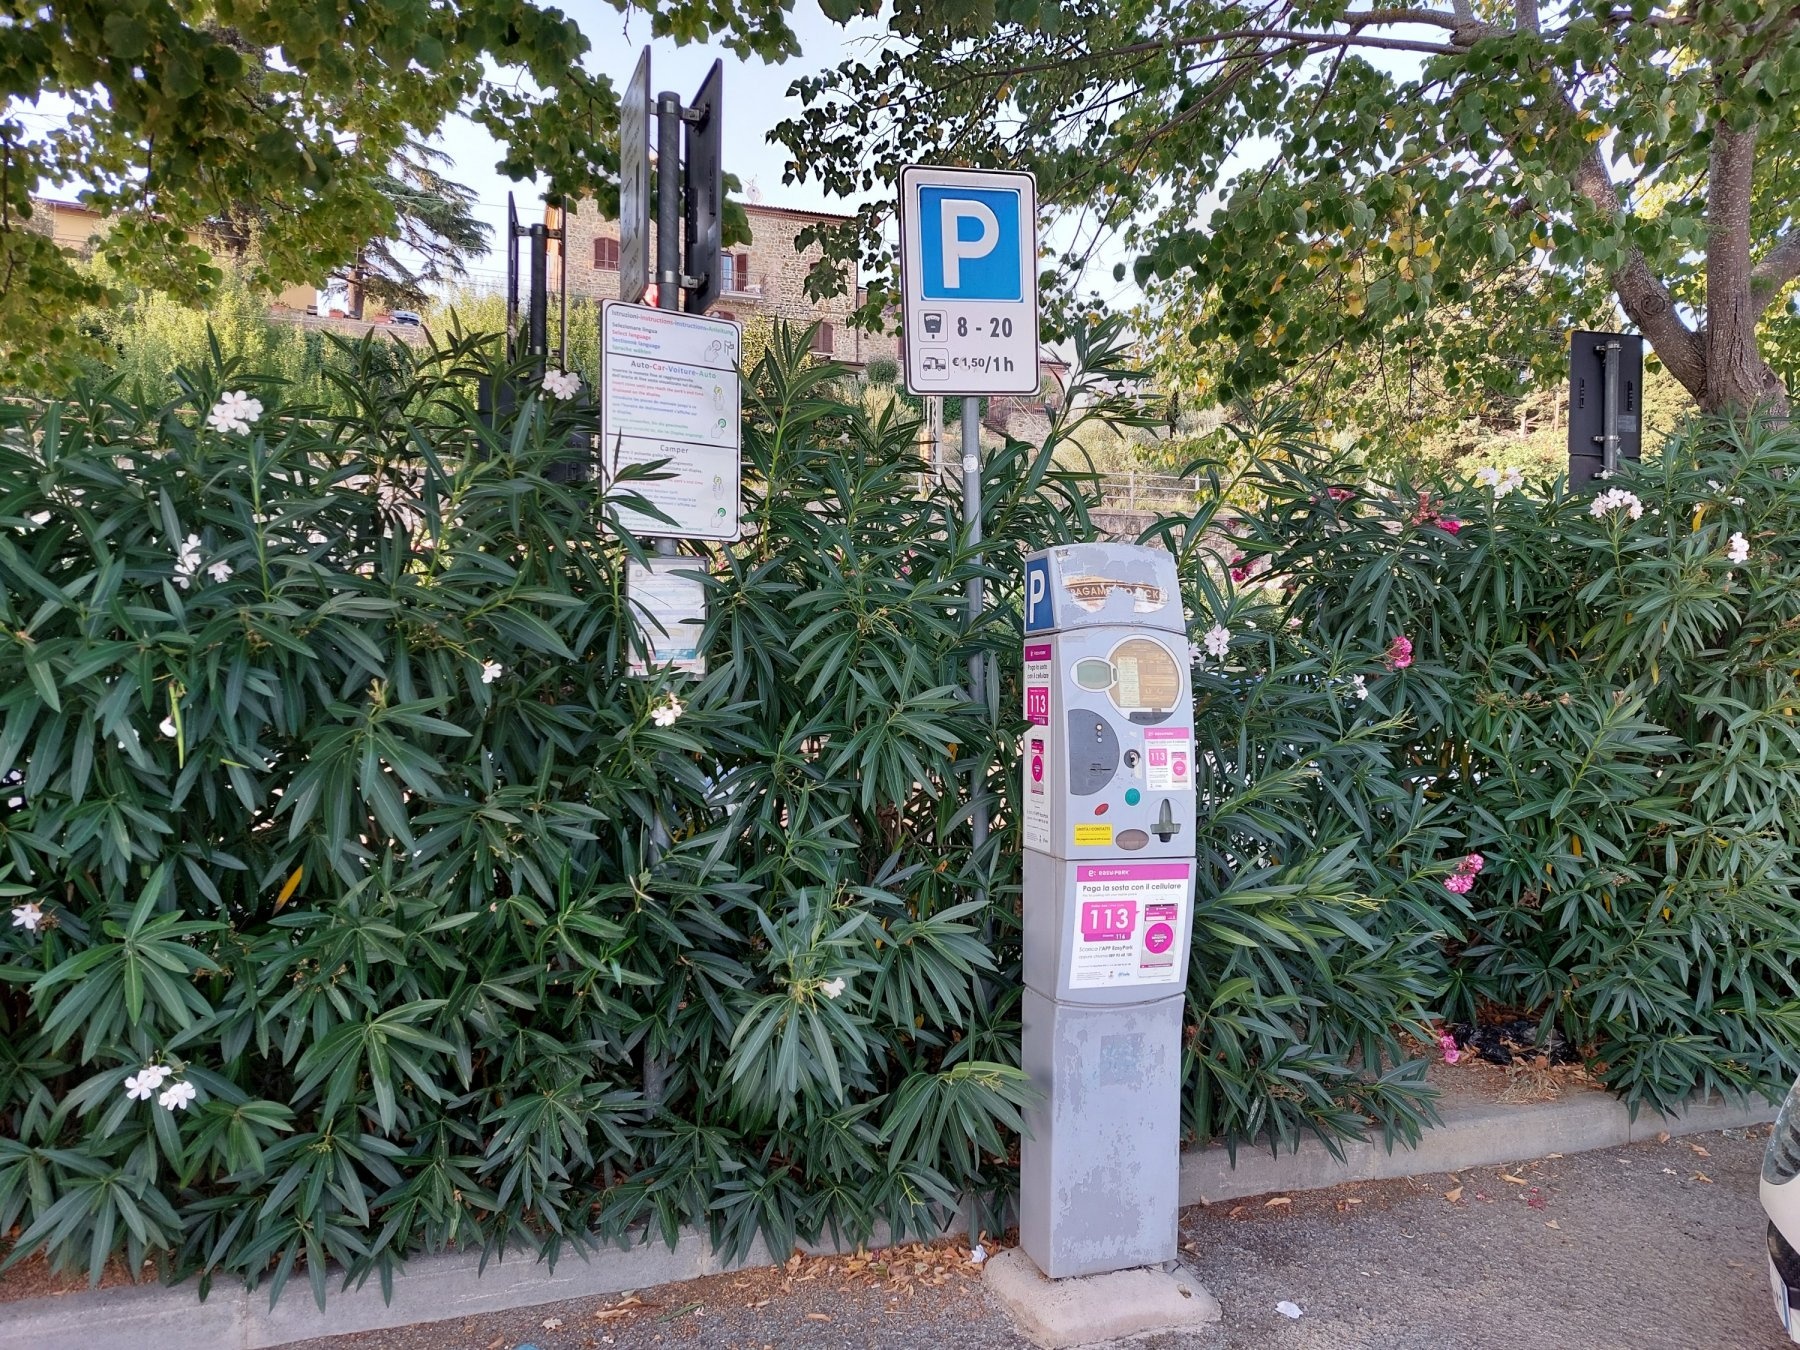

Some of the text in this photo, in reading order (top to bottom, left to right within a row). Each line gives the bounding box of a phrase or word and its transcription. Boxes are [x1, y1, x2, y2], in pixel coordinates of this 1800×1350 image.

[940, 198, 999, 289] P
[611, 329, 651, 341] Select language
[957, 316, 968, 337] 8
[989, 317, 1013, 338] 20
[630, 360, 717, 379] Auto-Car-Voiture-Auto
[660, 444, 689, 455] Camper
[1029, 569, 1046, 624] P
[1030, 694, 1046, 713] 113
[1150, 752, 1165, 761] 113
[1082, 885, 1101, 893] Paga
[1111, 884, 1130, 892] sosta
[1151, 882, 1182, 890] cellulare
[1090, 908, 1129, 929] 113
